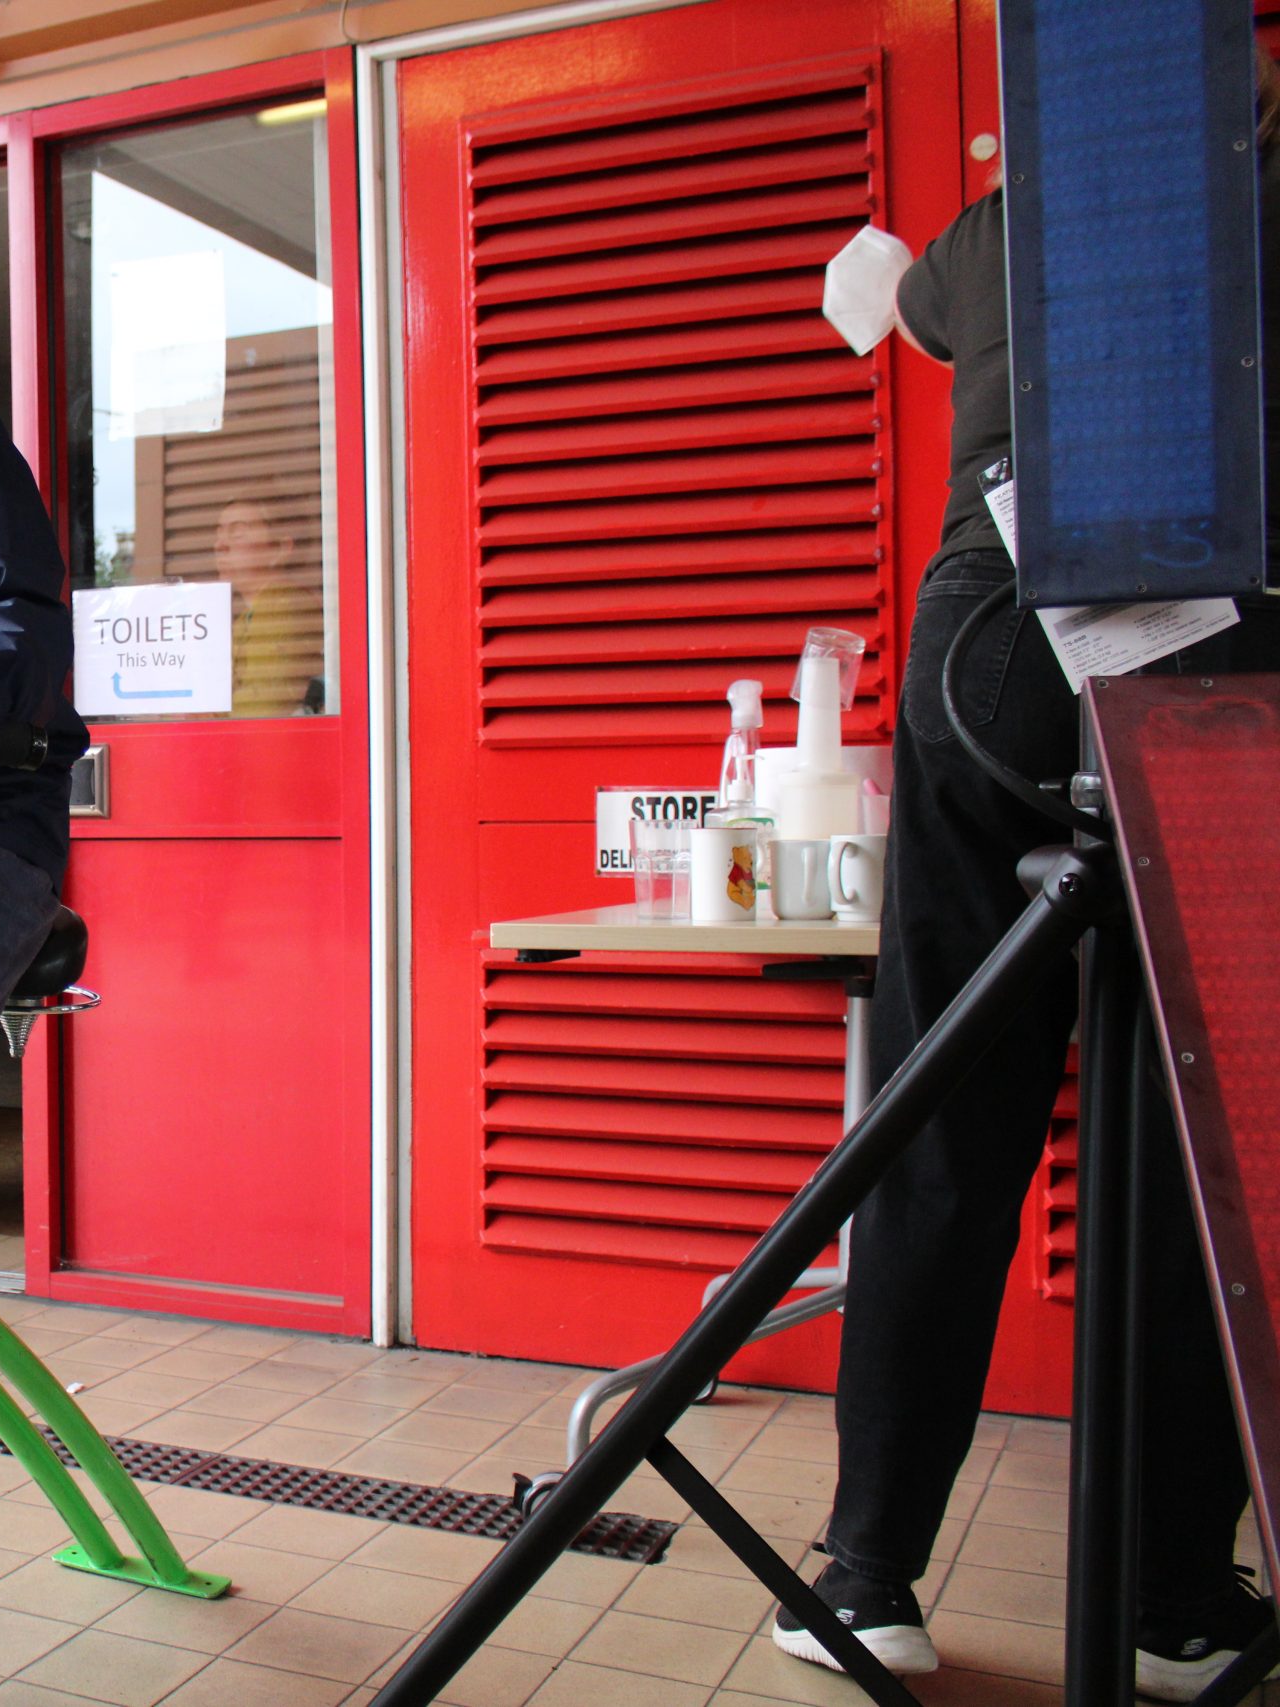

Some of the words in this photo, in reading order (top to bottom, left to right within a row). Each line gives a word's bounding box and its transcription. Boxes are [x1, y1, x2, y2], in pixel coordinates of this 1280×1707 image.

[94, 613, 208, 645] TOILETS
[117, 652, 147, 668] This
[152, 651, 186, 669] Way
